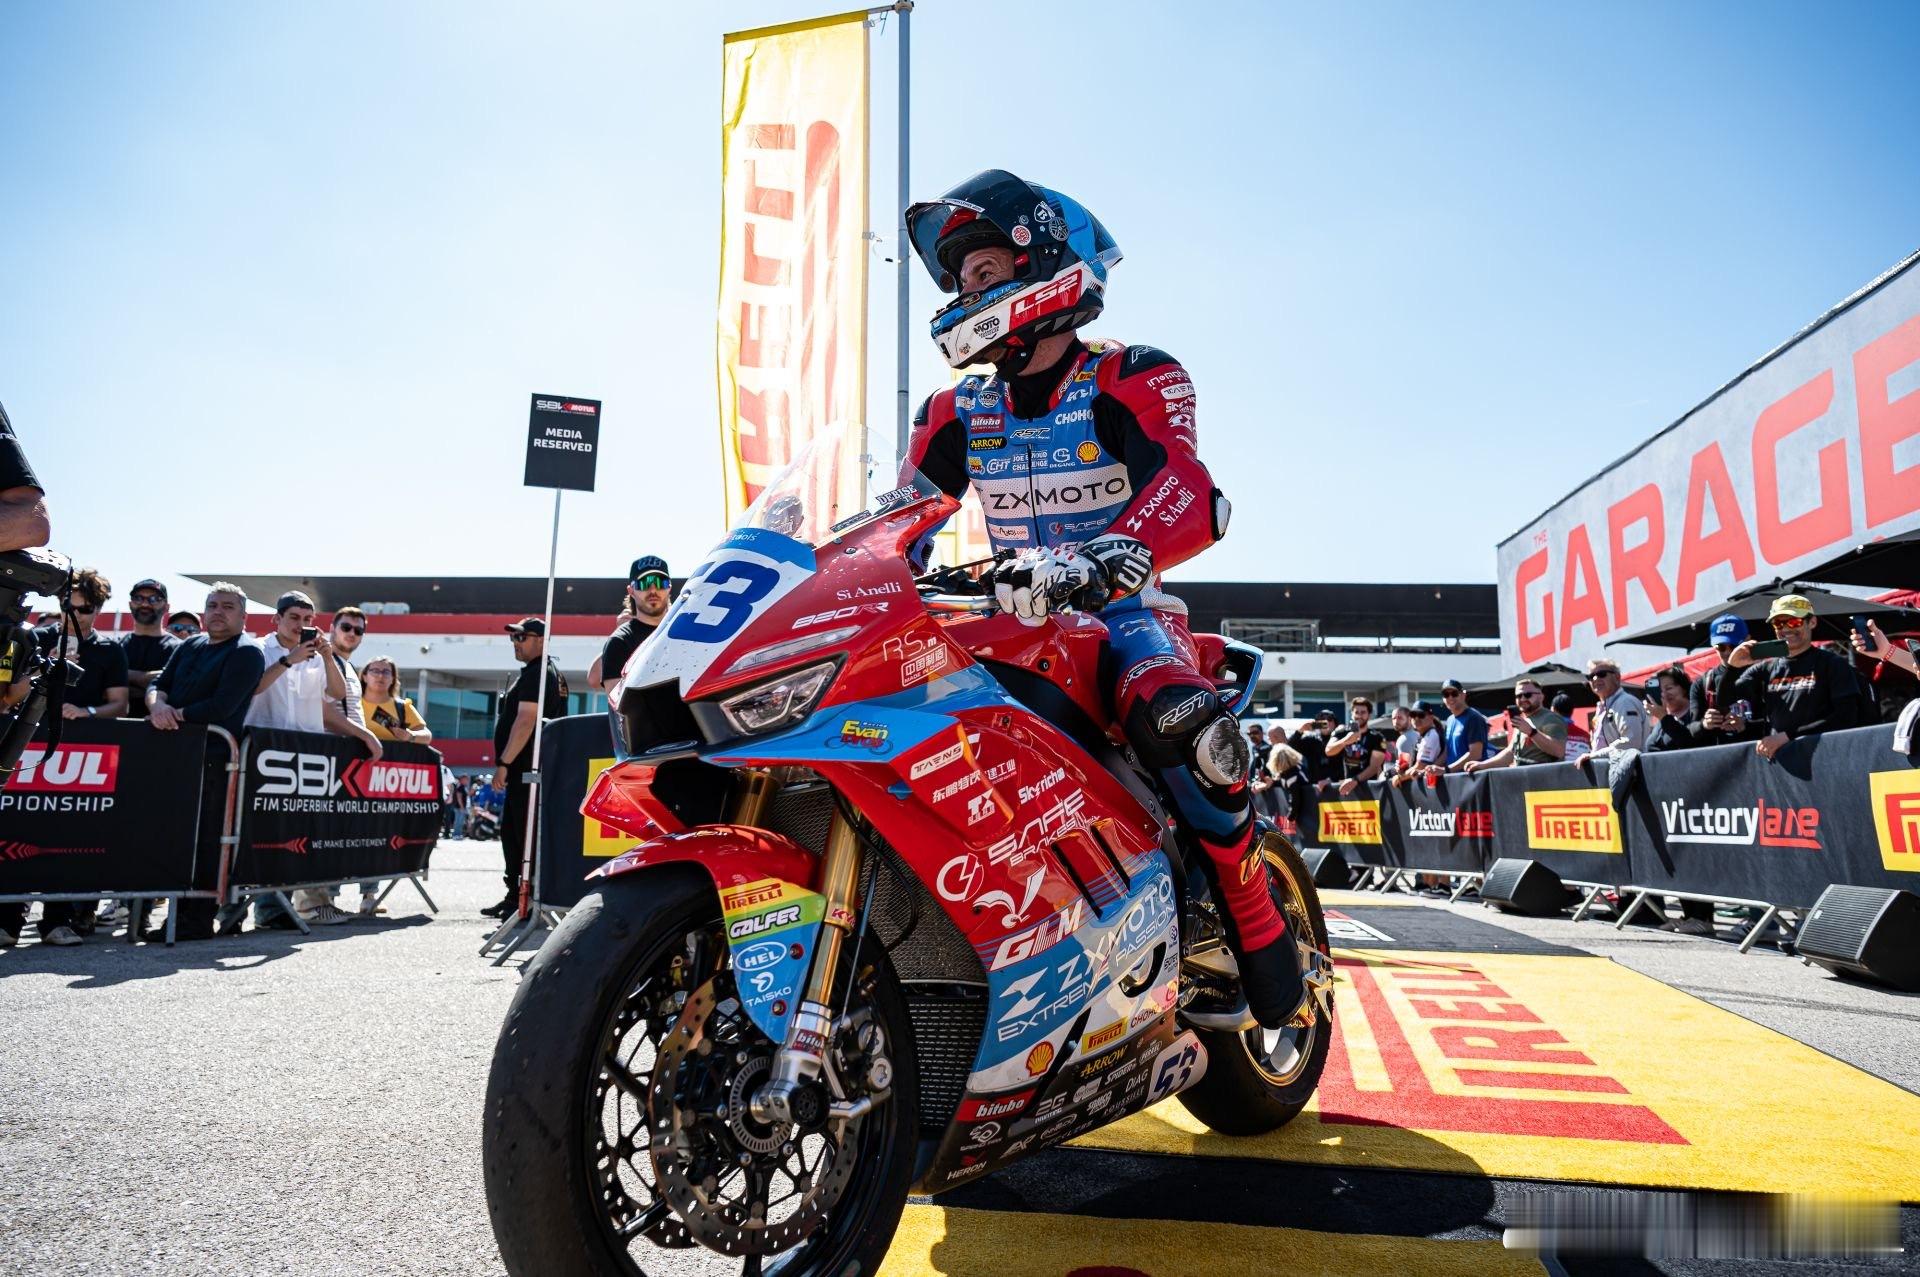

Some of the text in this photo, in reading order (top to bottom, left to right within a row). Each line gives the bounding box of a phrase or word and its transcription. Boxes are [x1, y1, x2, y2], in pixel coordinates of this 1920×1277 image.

[1014, 273, 1079, 315] LS2
[973, 316, 1000, 335] MOTO
[570, 403, 596, 413] MOTUL
[1054, 409, 1094, 426] CHOHO
[545, 427, 583, 440] MEDIA
[970, 438, 1003, 448] ARROW
[533, 438, 593, 453] RESERVED
[876, 484, 918, 506] DEBISE
[989, 477, 1127, 510] ZXMOTO
[1138, 475, 1180, 519] ZXMOTO
[1515, 313, 1920, 665] GARAGE
[1533, 529, 1548, 547] THE
[854, 581, 903, 599] Anelli
[1158, 690, 1209, 734] RST
[841, 720, 889, 740] Evan
[368, 765, 433, 795] MOTUL
[0, 795, 115, 812] PIONSHIP
[253, 797, 279, 812] FIM
[283, 798, 334, 813] SUPERBIKE
[336, 800, 369, 813] WORLD
[1324, 809, 1377, 836] PIRELLI
[1533, 803, 1612, 841] PIRELLI
[312, 837, 387, 849] WE MAKE EXCITEMENT
[723, 882, 783, 911] PIRELLI
[730, 905, 801, 939] GALFER
[1115, 898, 1176, 967] PASSION
[744, 950, 781, 968] HEL
[745, 986, 792, 1007] TAISKO
[796, 1032, 824, 1048] bitu
[1087, 1022, 1123, 1050] PIRELLI
[1080, 1045, 1129, 1078] ARROW
[975, 1099, 1025, 1118] bitubo
[946, 1161, 987, 1181] HERON
